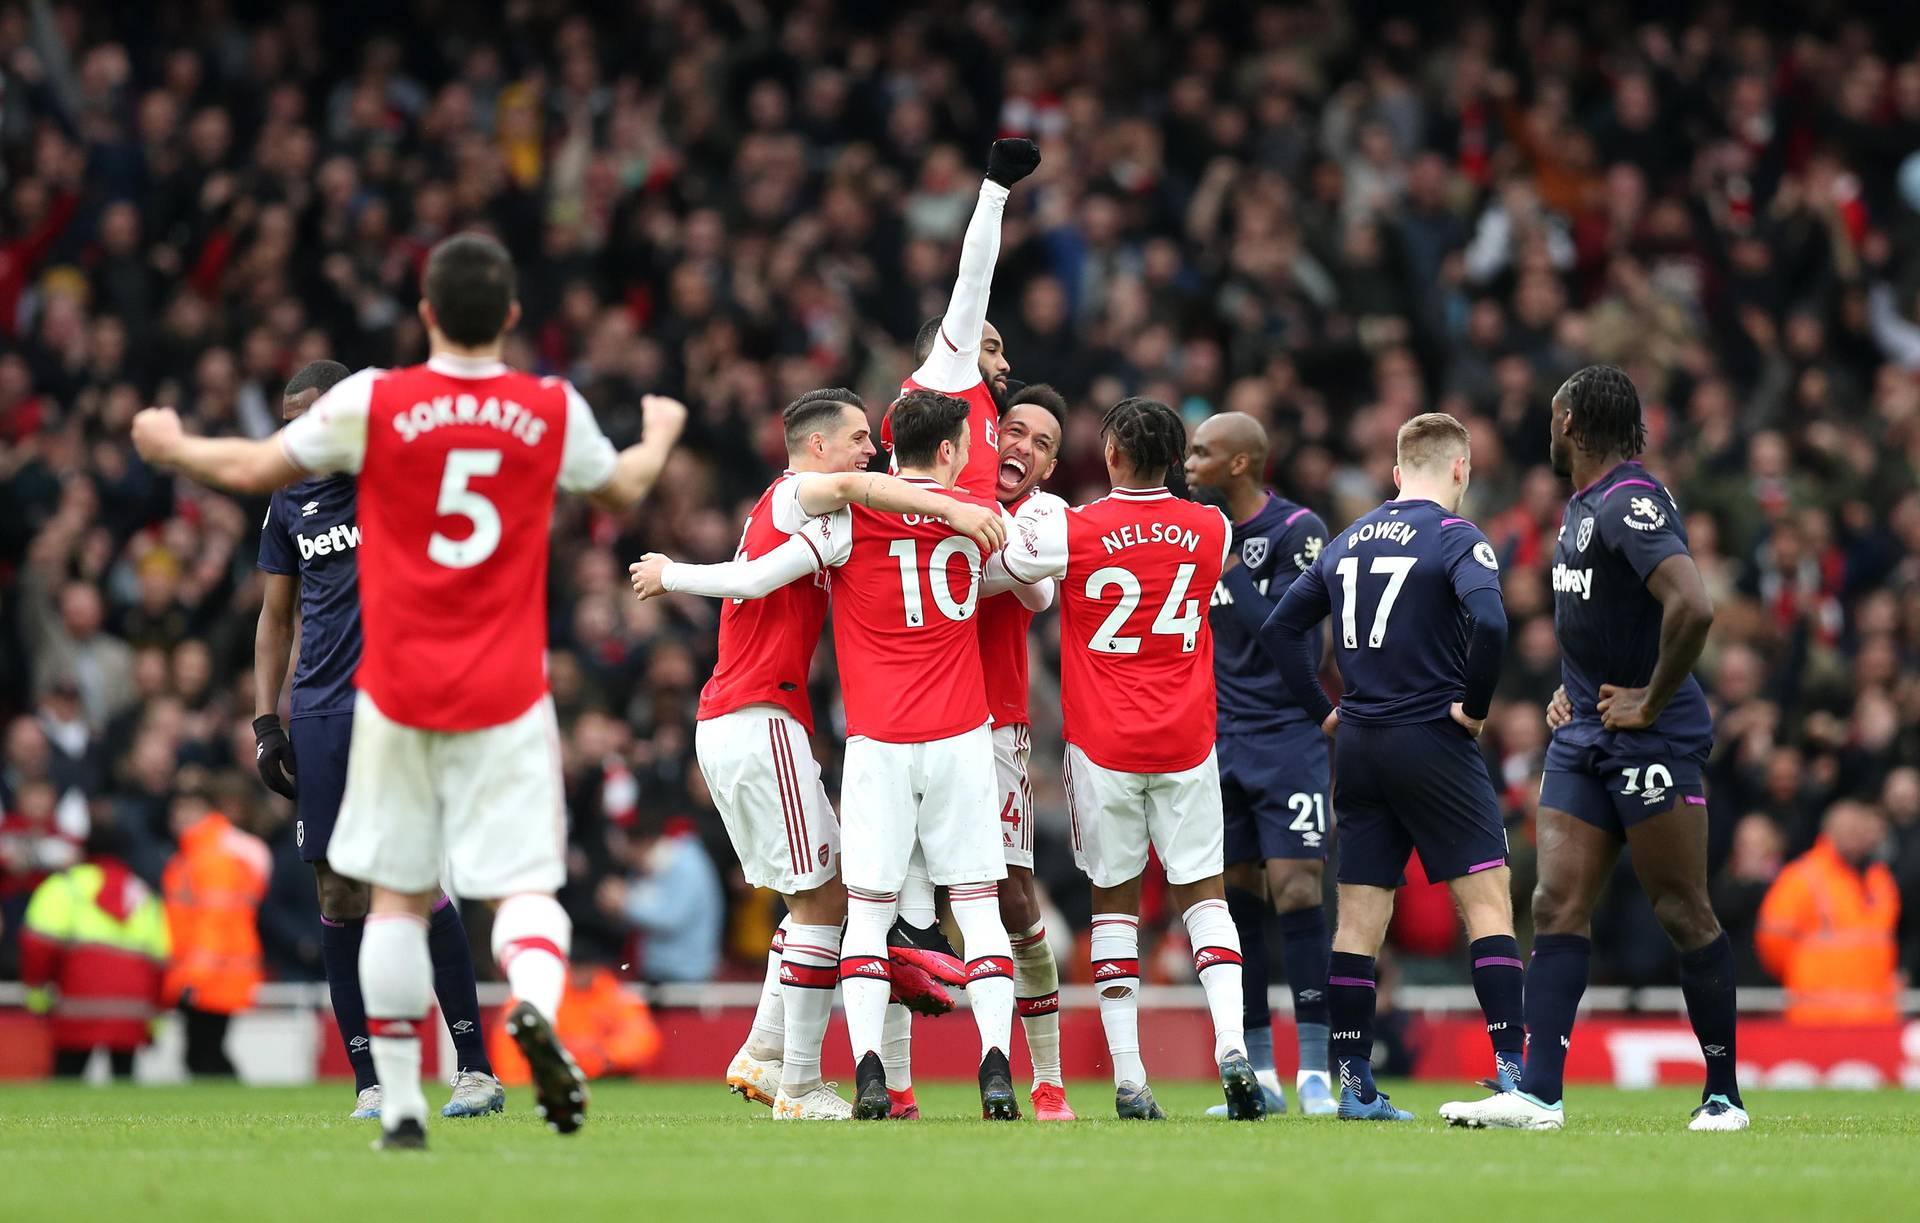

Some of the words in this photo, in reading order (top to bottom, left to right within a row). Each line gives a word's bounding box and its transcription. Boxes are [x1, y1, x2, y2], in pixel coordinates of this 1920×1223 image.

[393, 393, 546, 447] SOKRATIS
[427, 449, 502, 570] 5
[1100, 522, 1201, 555] NELSON
[1348, 521, 1418, 551] BOWEN
[888, 535, 983, 628] 10
[1085, 563, 1202, 654] 24
[1335, 556, 1419, 649] 17
[1000, 791, 1021, 831] 4
[1288, 792, 1326, 832] 21
[969, 966, 1003, 977] adidas
[1332, 1030, 1361, 1040] WHU
